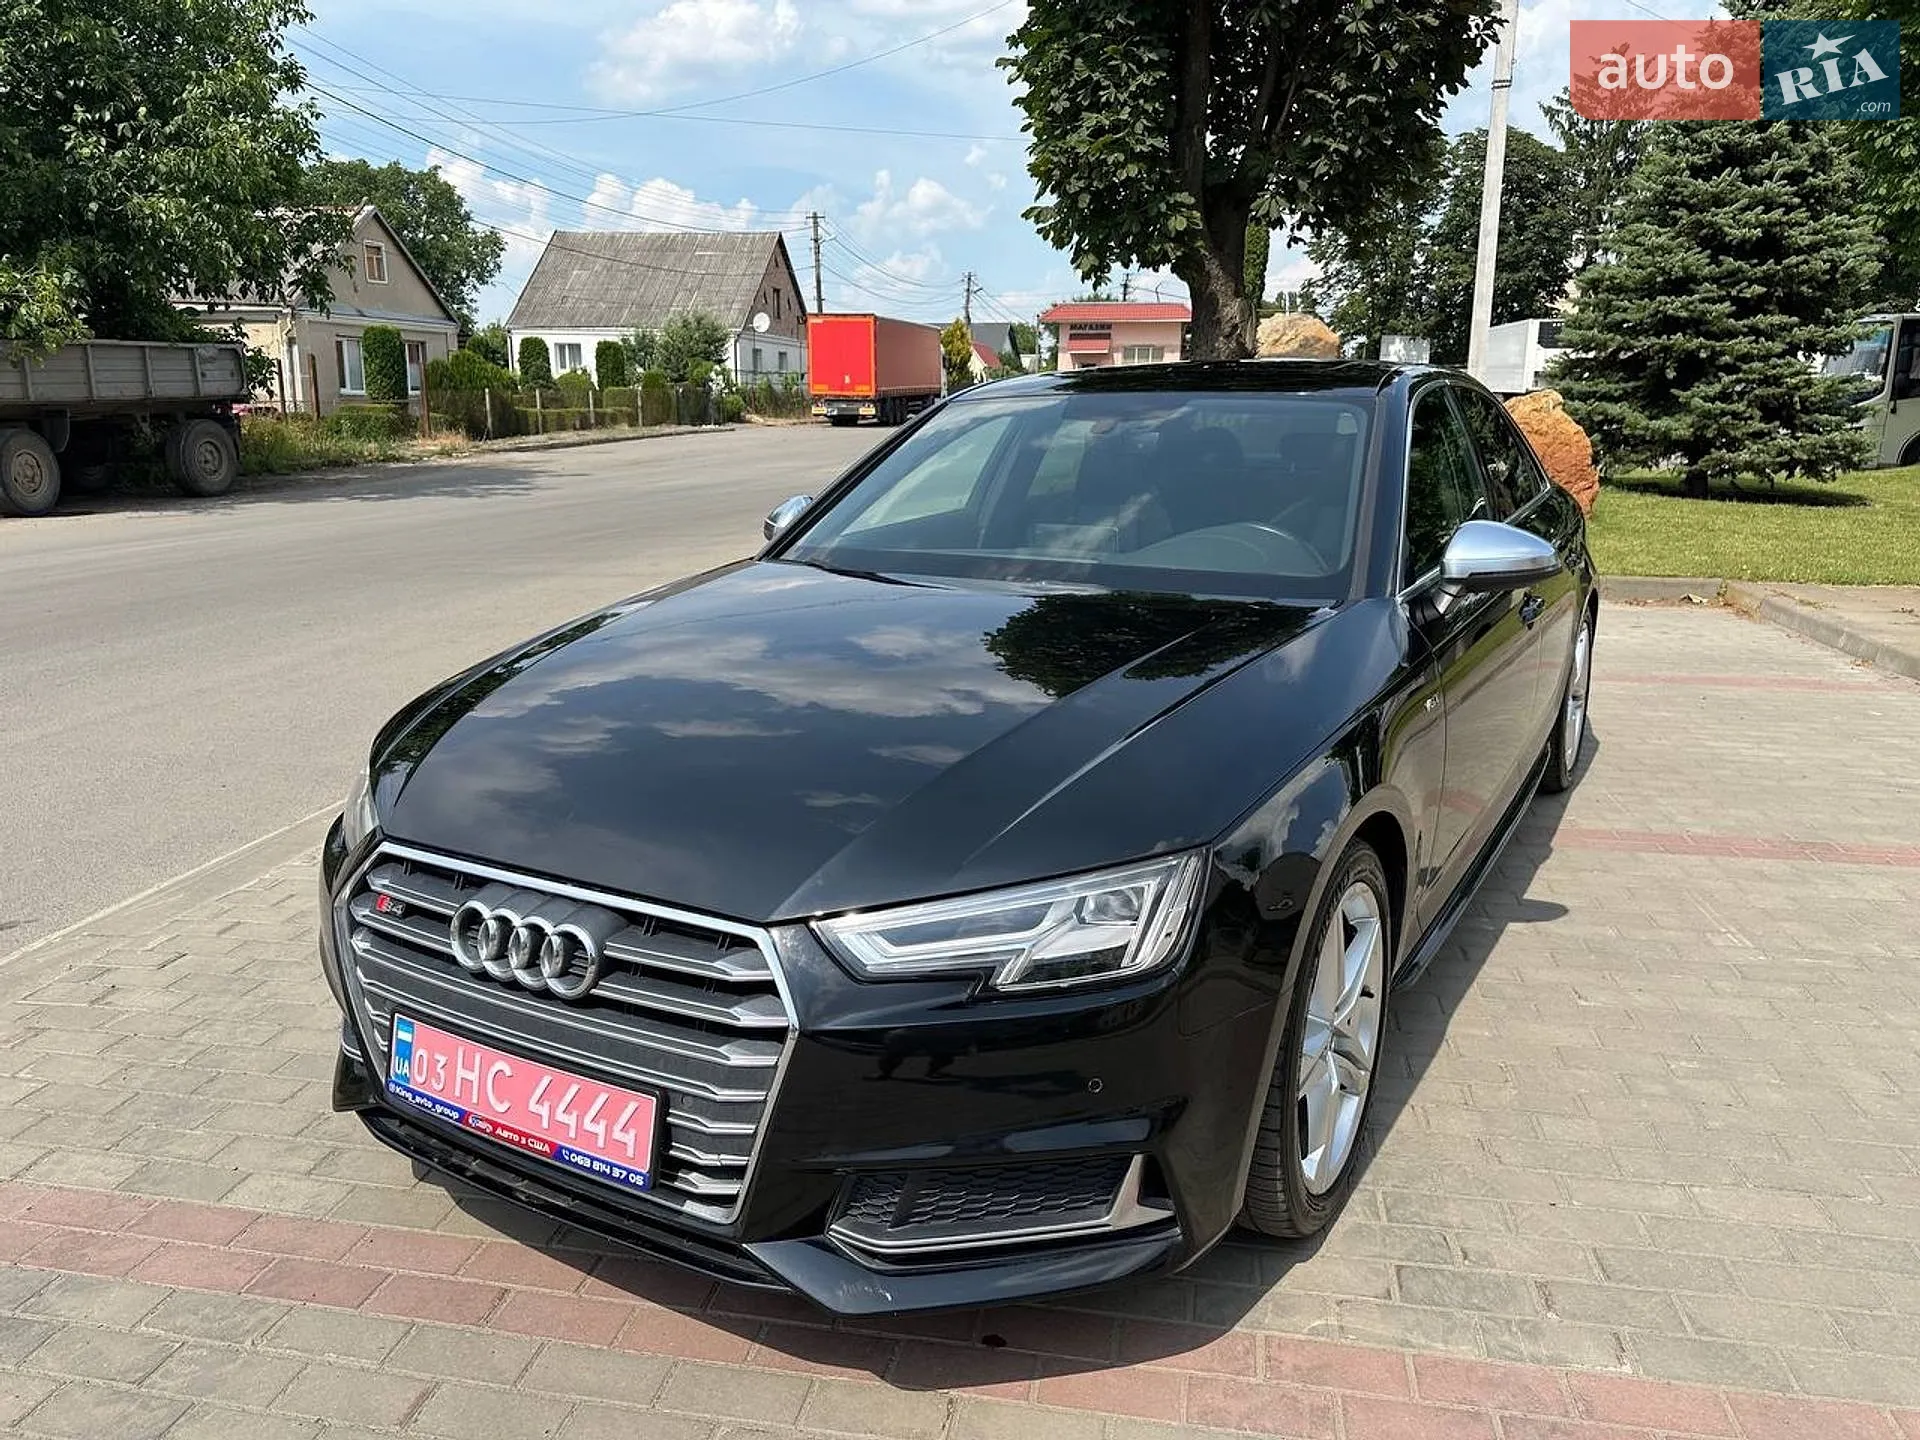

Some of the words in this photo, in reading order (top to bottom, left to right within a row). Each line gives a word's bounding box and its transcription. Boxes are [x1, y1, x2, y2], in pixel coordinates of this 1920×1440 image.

[395, 1057, 410, 1079] UA
[412, 1048, 447, 1092] 03
[527, 1075, 640, 1158] 4444
[528, 1138, 551, 1153] США
[592, 1160, 610, 1174] 814
[628, 1173, 644, 1186] 05
